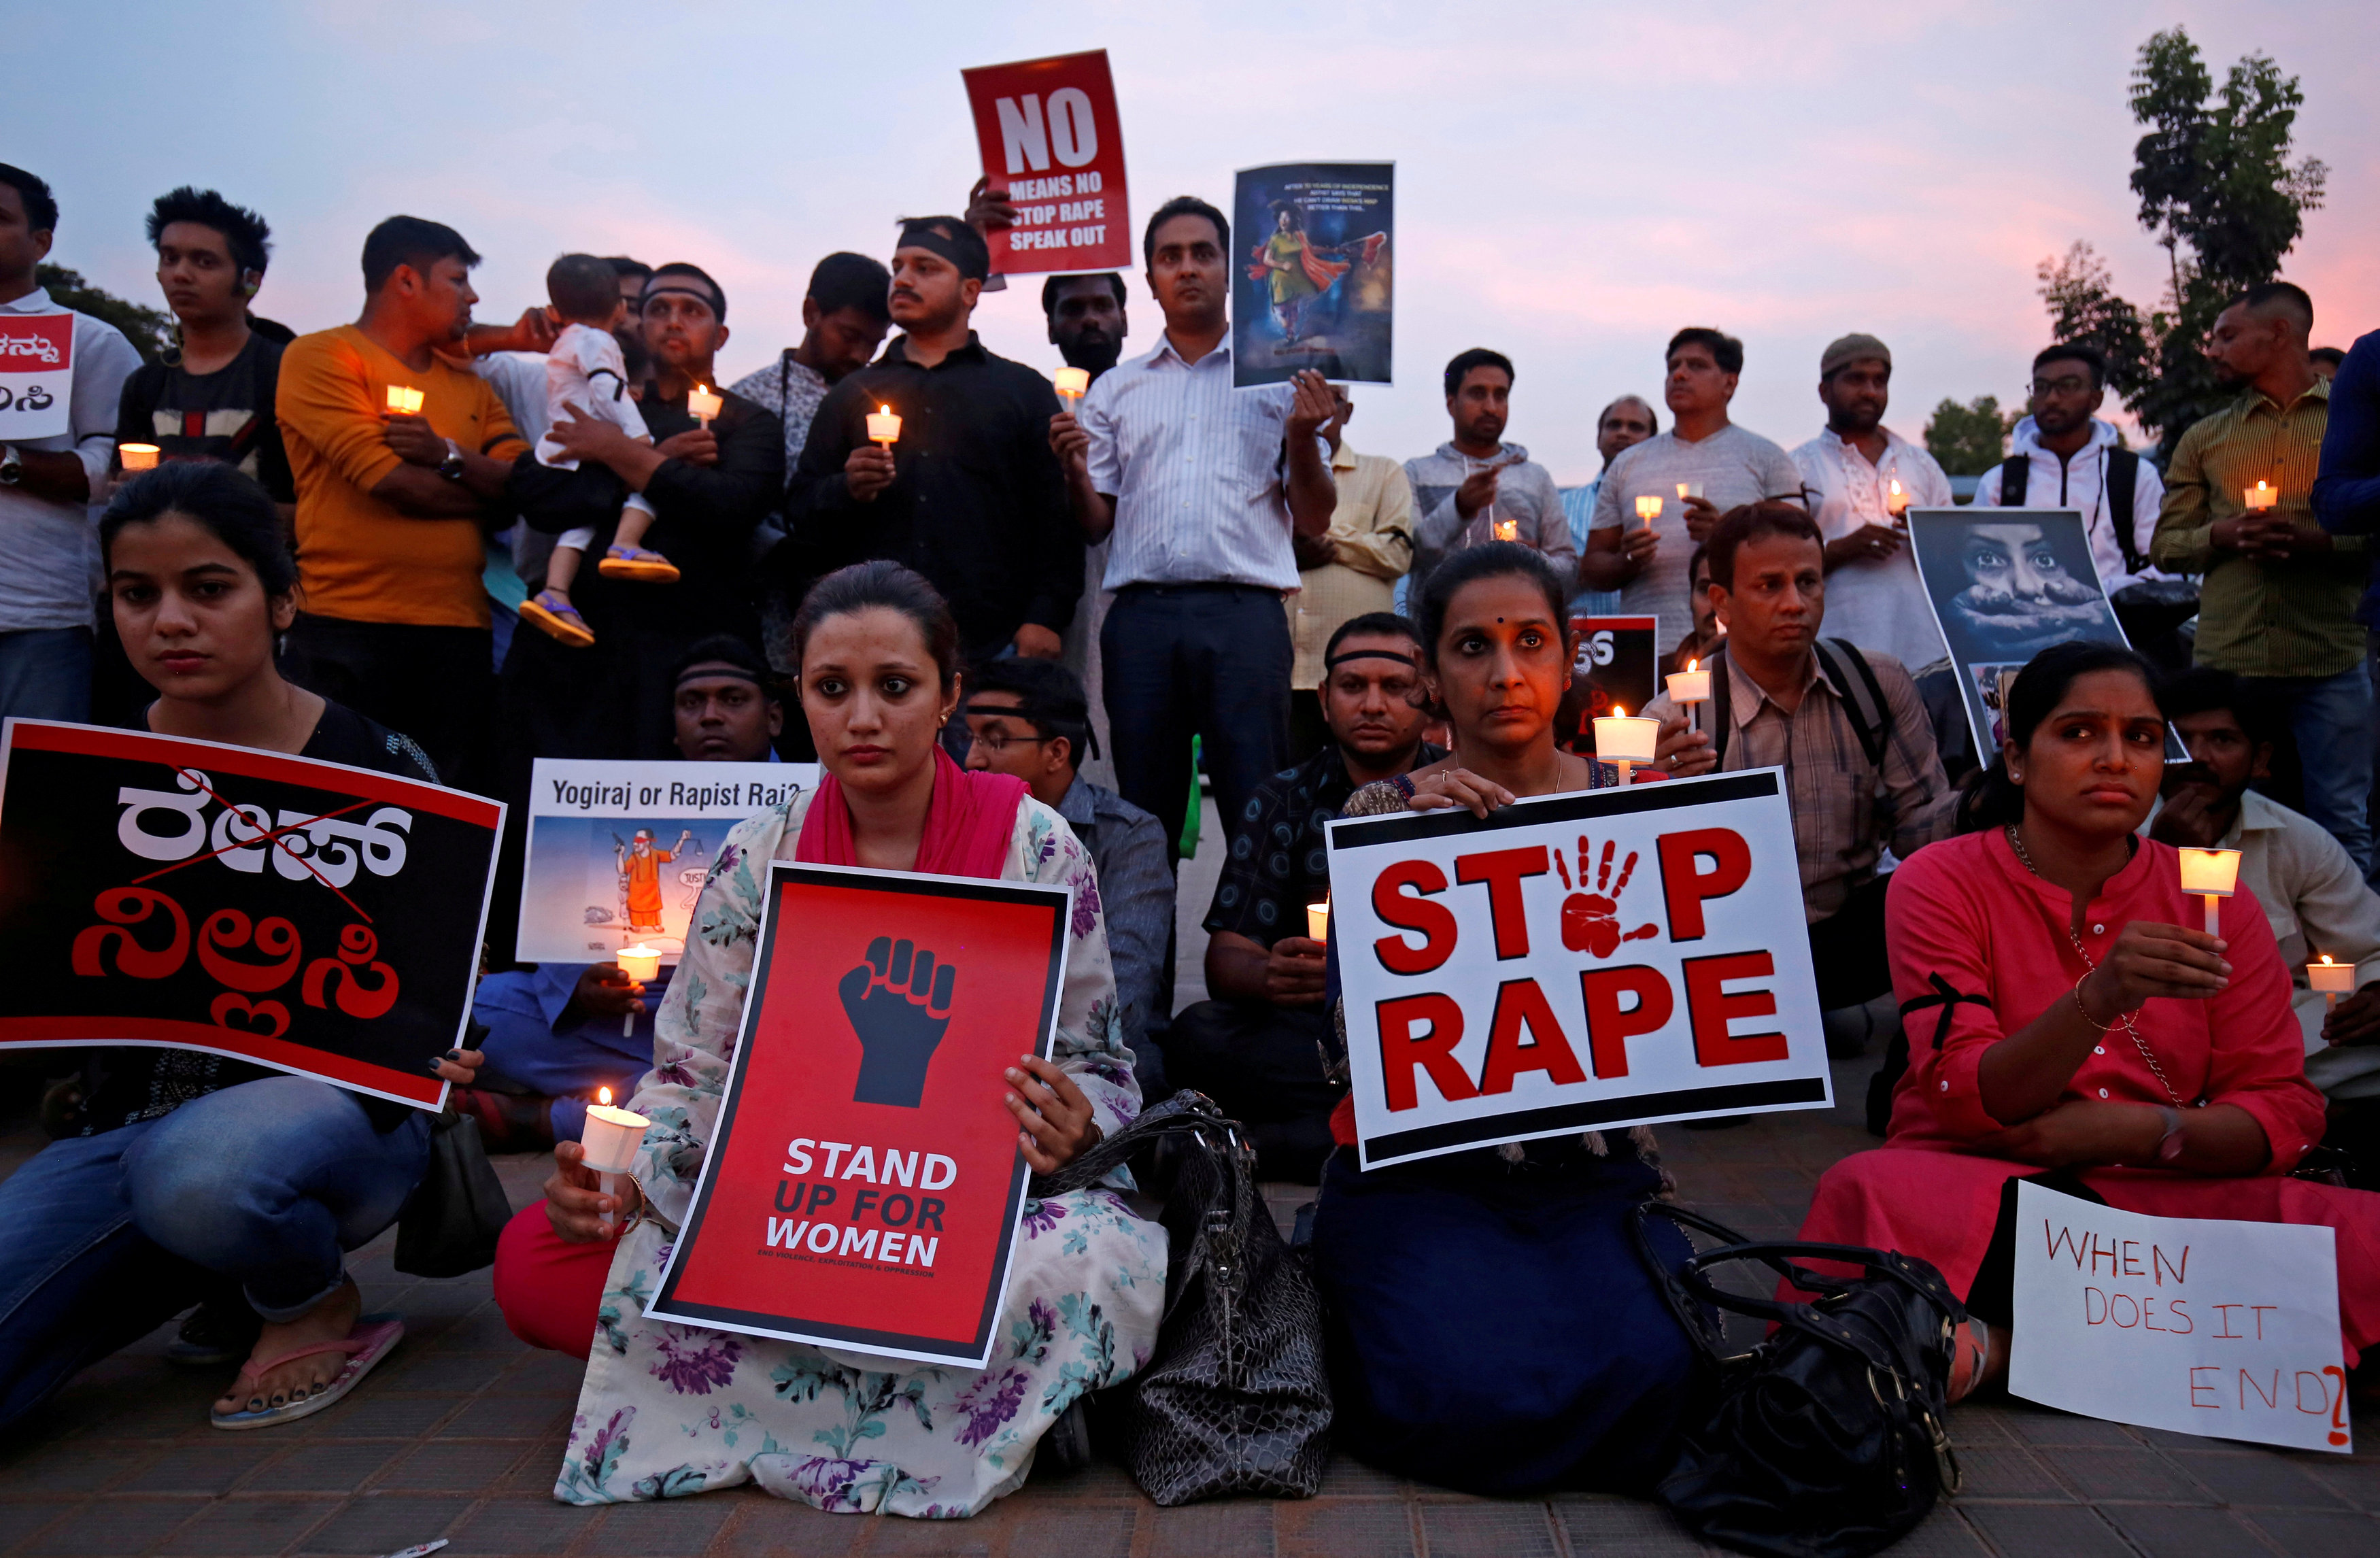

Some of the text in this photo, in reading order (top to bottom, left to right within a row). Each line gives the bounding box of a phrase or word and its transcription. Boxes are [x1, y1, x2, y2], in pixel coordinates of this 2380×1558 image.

[995, 87, 1098, 174] NO
[1008, 171, 1102, 201] MEANS NO
[1059, 199, 1104, 222] RAPE
[1010, 224, 1106, 251] SPEAK OUT
[553, 779, 632, 811] Yogiraj
[639, 787, 662, 805] or
[670, 783, 740, 811] Rapist
[1375, 949, 1790, 1113] RAPE
[783, 1138, 957, 1190] STAND
[774, 1180, 946, 1232] UP FOR
[766, 1217, 938, 1268] WOMEN
[776, 1251, 815, 1263] VIOLENCE,
[818, 1257, 873, 1270] EXPLOITATION
[884, 1266, 934, 1278] OPPRESSION
[2045, 1219, 2189, 1287] WHEN
[2085, 1287, 2277, 1340] DOES IT
[2190, 1366, 2349, 1446] END?
